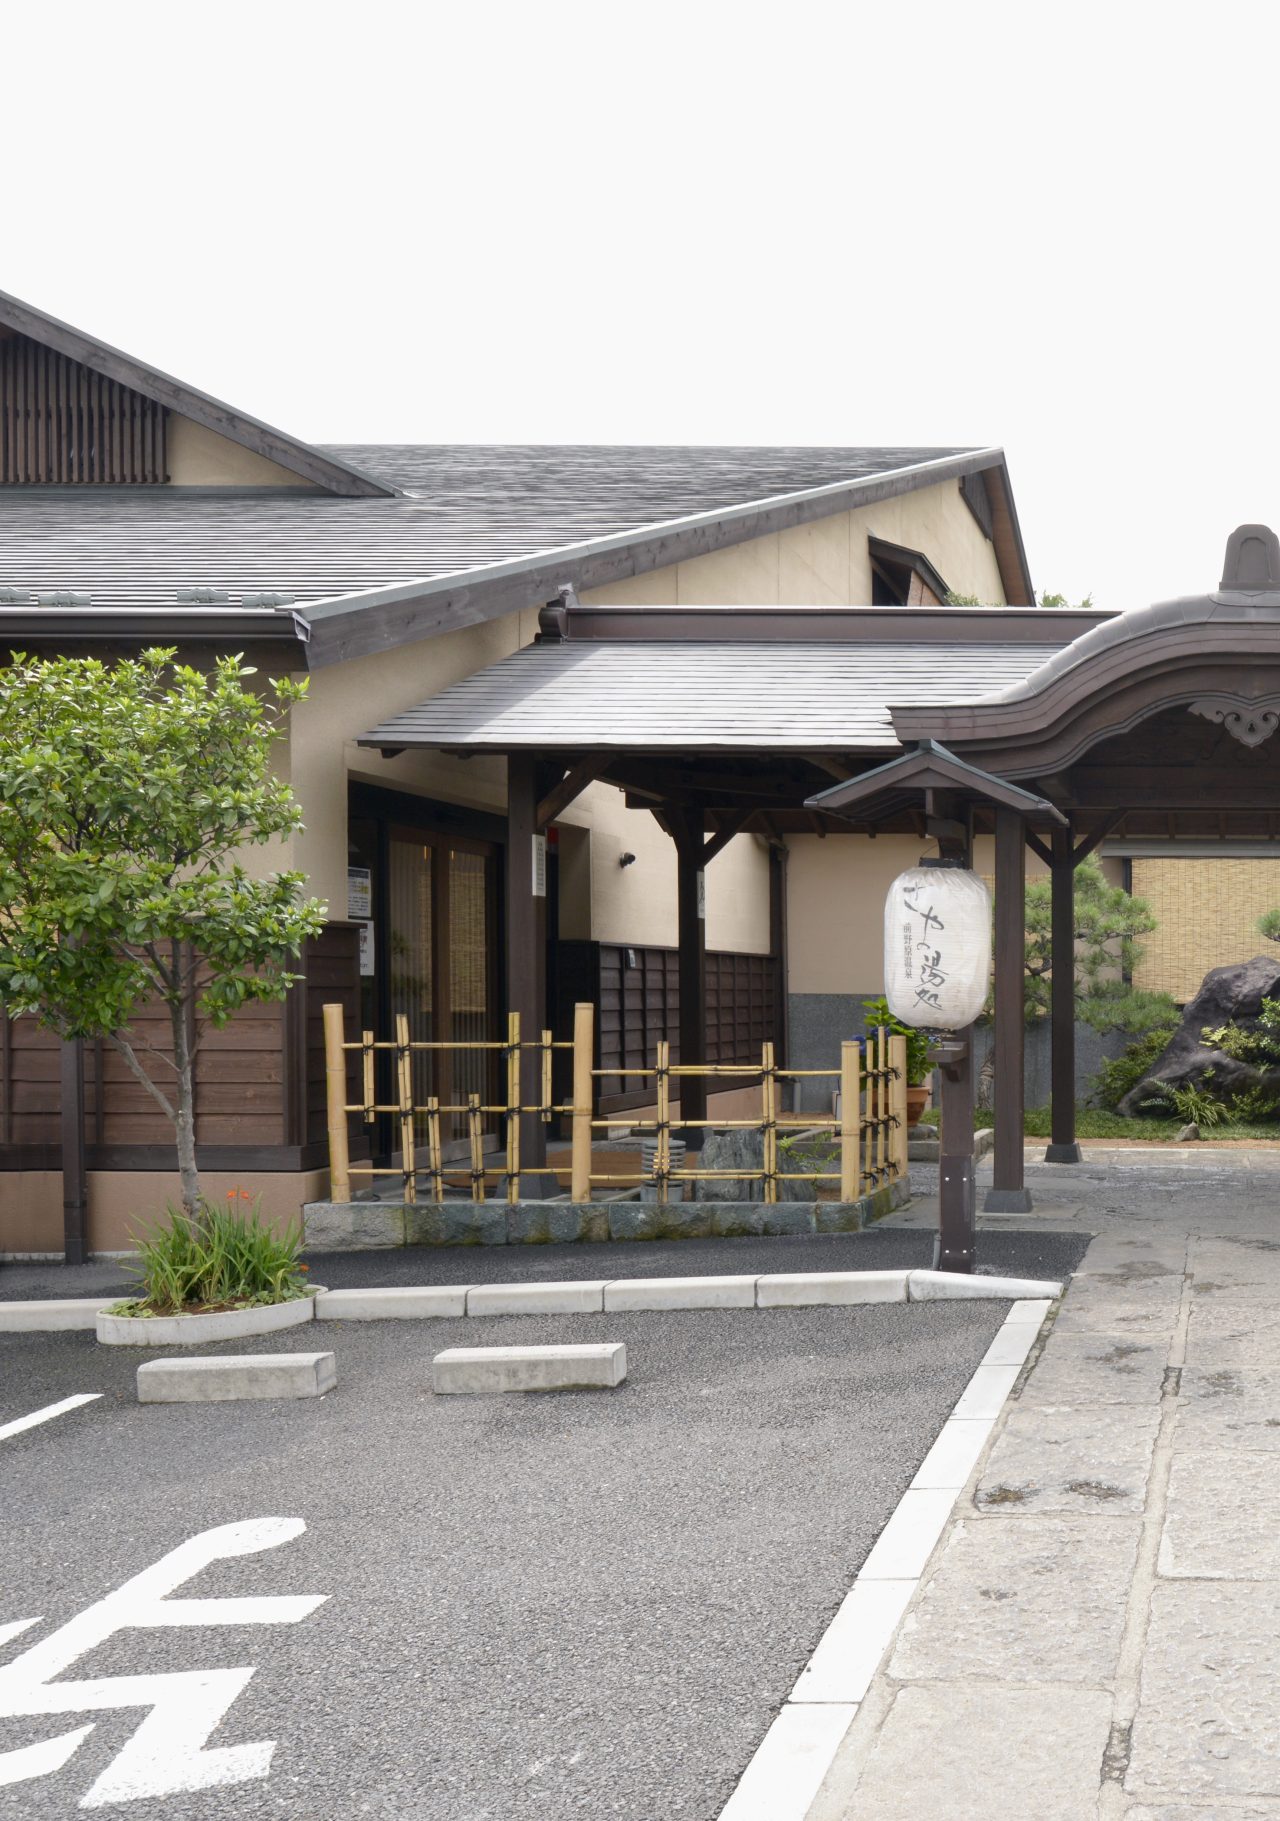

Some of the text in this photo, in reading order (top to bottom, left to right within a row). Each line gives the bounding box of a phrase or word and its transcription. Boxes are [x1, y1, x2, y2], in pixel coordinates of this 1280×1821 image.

[903, 881, 949, 1010] さやの湯処
